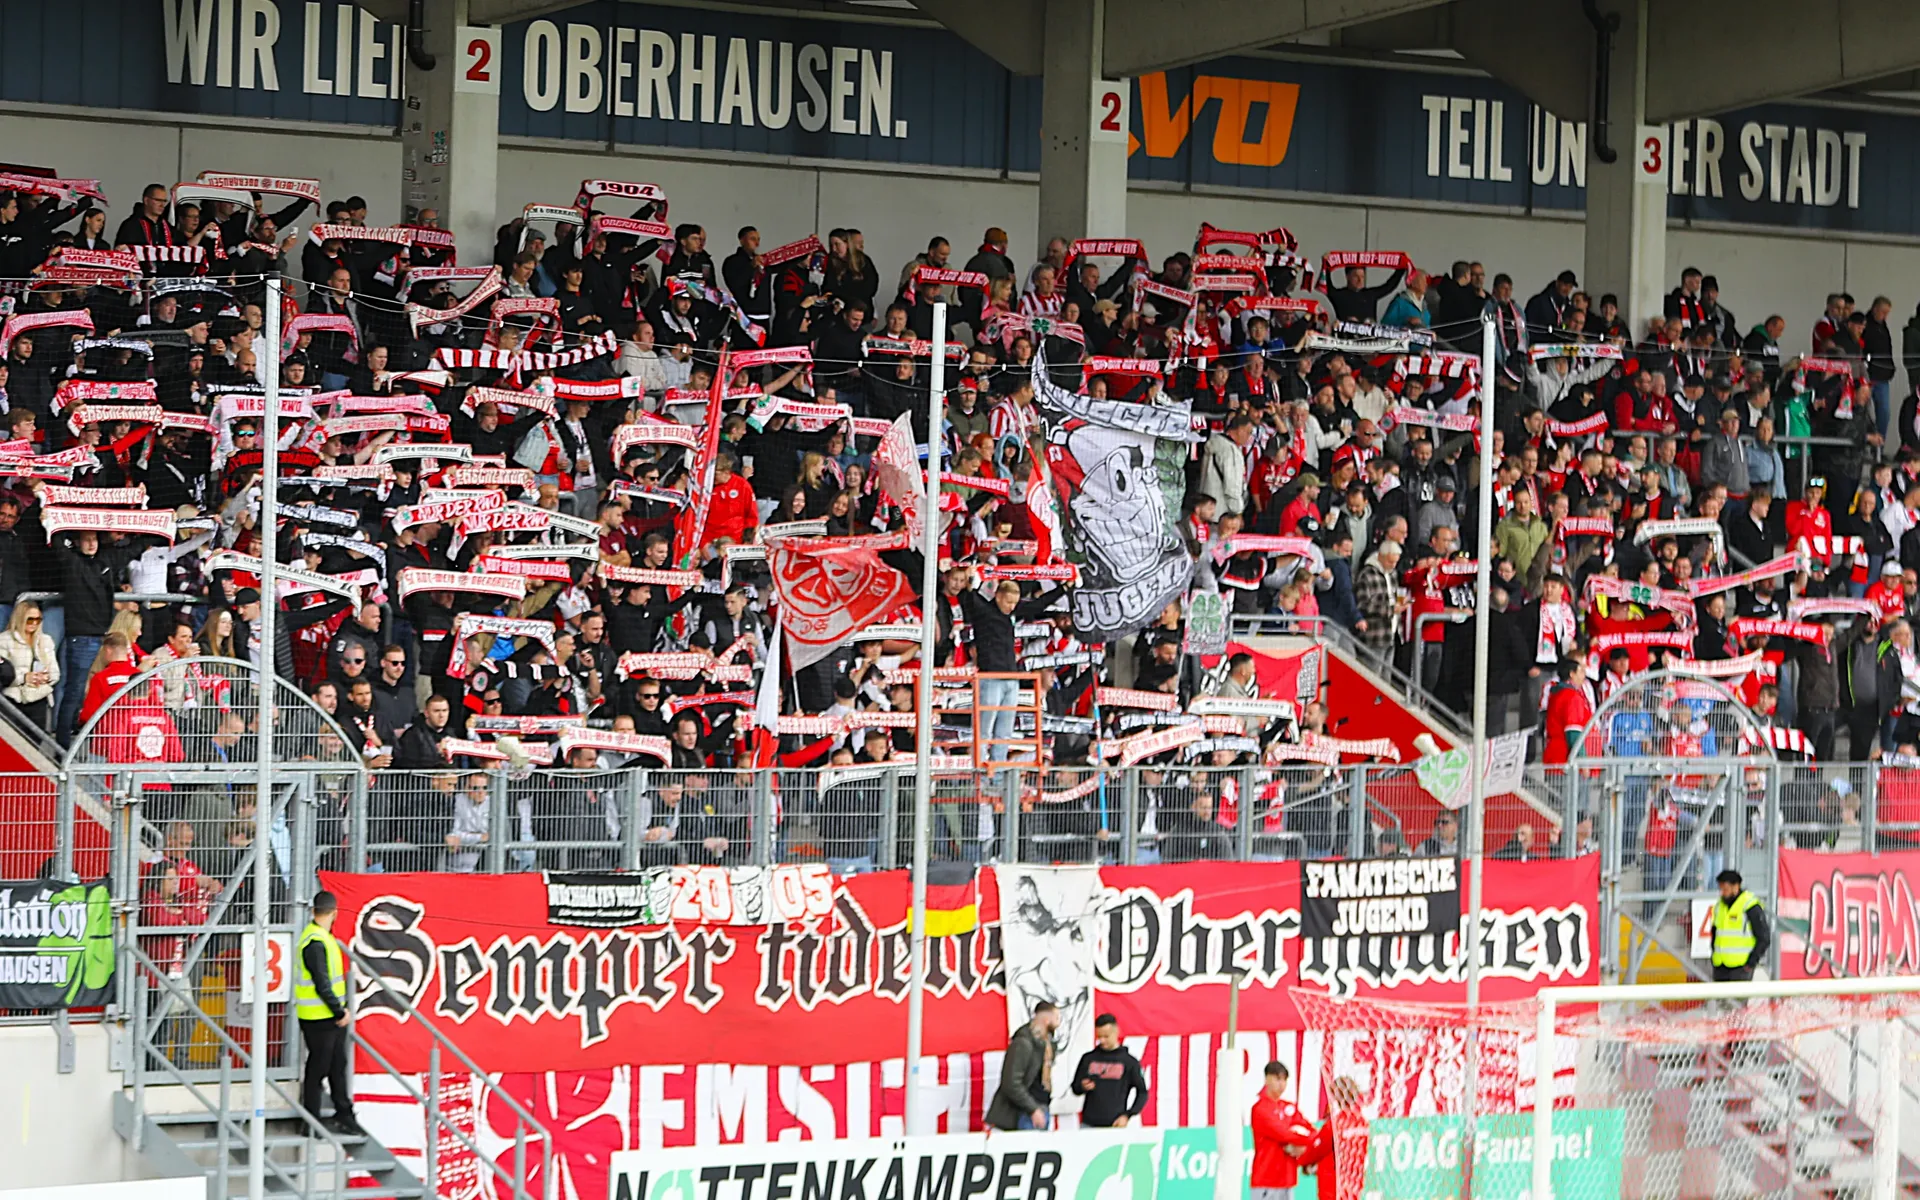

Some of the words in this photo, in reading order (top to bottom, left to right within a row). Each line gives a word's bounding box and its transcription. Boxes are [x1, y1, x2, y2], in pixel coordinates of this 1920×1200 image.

[163, 0, 281, 91] WIR
[523, 20, 908, 139] OBERHAUSEN.
[466, 39, 491, 82] 2
[1100, 91, 1122, 132] 2
[1422, 95, 1513, 183] TEIL
[1739, 122, 1868, 209] STADT
[1643, 137, 1662, 174] 3
[600, 182, 655, 197] 1904
[601, 218, 666, 235] OBERHAUSEN
[1342, 253, 1356, 265] BIN
[236, 399, 255, 411] WIR
[116, 513, 170, 527] OBERHAUSEN
[417, 503, 447, 520] NUR
[446, 498, 476, 517] DER
[475, 492, 502, 511] RWO
[463, 512, 494, 532] NUR
[493, 511, 521, 528] DER
[243, 556, 262, 567] ULM
[671, 864, 734, 924] 20
[772, 864, 834, 922] 05
[1305, 857, 1457, 898] FANATISCHE
[1332, 898, 1431, 936] JUGEND
[352, 895, 736, 1050] Semper
[1372, 1128, 1459, 1172] TOAG
